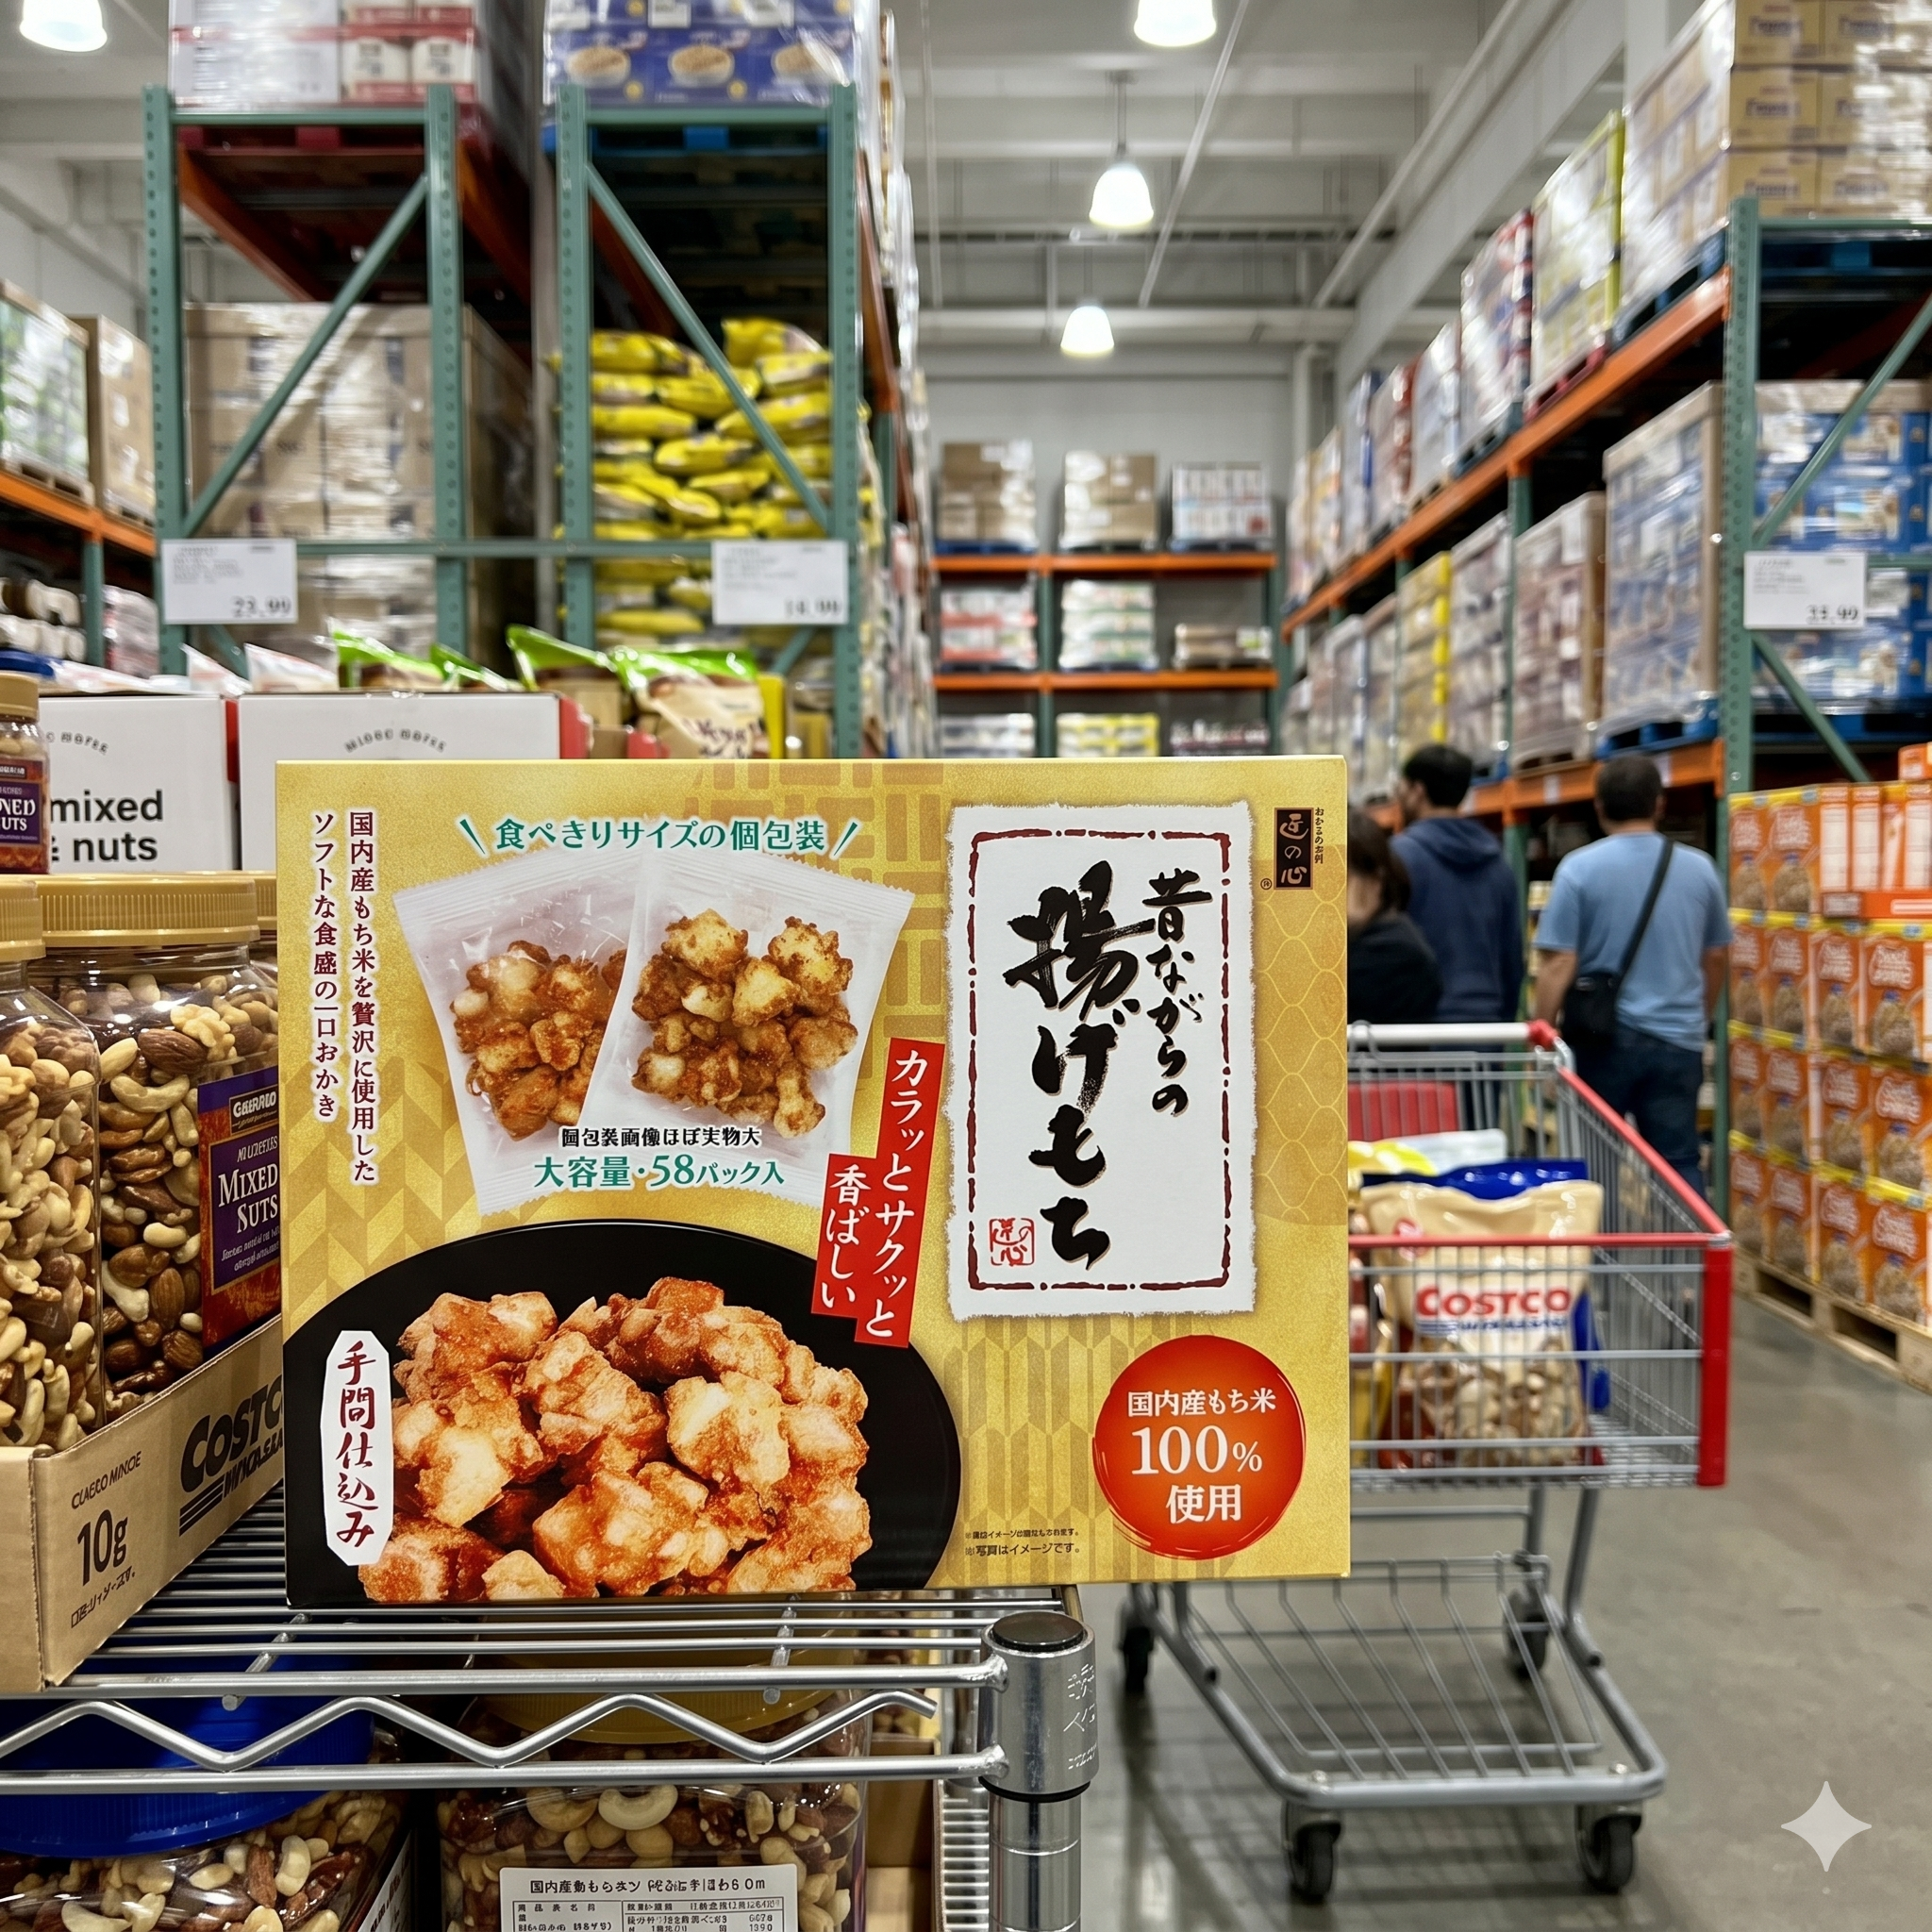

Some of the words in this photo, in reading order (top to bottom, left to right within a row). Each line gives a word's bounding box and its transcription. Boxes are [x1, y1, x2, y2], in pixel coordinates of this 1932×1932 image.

[0, 798, 36, 817] NED
[50, 789, 163, 823] mixed
[74, 832, 158, 862] nuts
[495, 818, 826, 851] 食べきりサイズの個包装
[350, 811, 375, 1182] 国内産もち米を贅沢に使用した
[1142, 868, 1213, 1115] 昔ながらの
[1003, 860, 1157, 1270] 揚げもち
[218, 1163, 278, 1208] MIXED
[866, 1049, 928, 1338] カラッとサクッと
[822, 1163, 872, 1308] 香ばしい
[1417, 1287, 1571, 1317] COSTCO
[1127, 1388, 1276, 1417] 国内産もち米
[180, 1374, 283, 1493] COSTC
[1132, 1425, 1262, 1474] 100%
[1166, 1484, 1241, 1524] 使用
[76, 1508, 128, 1587] 10g
